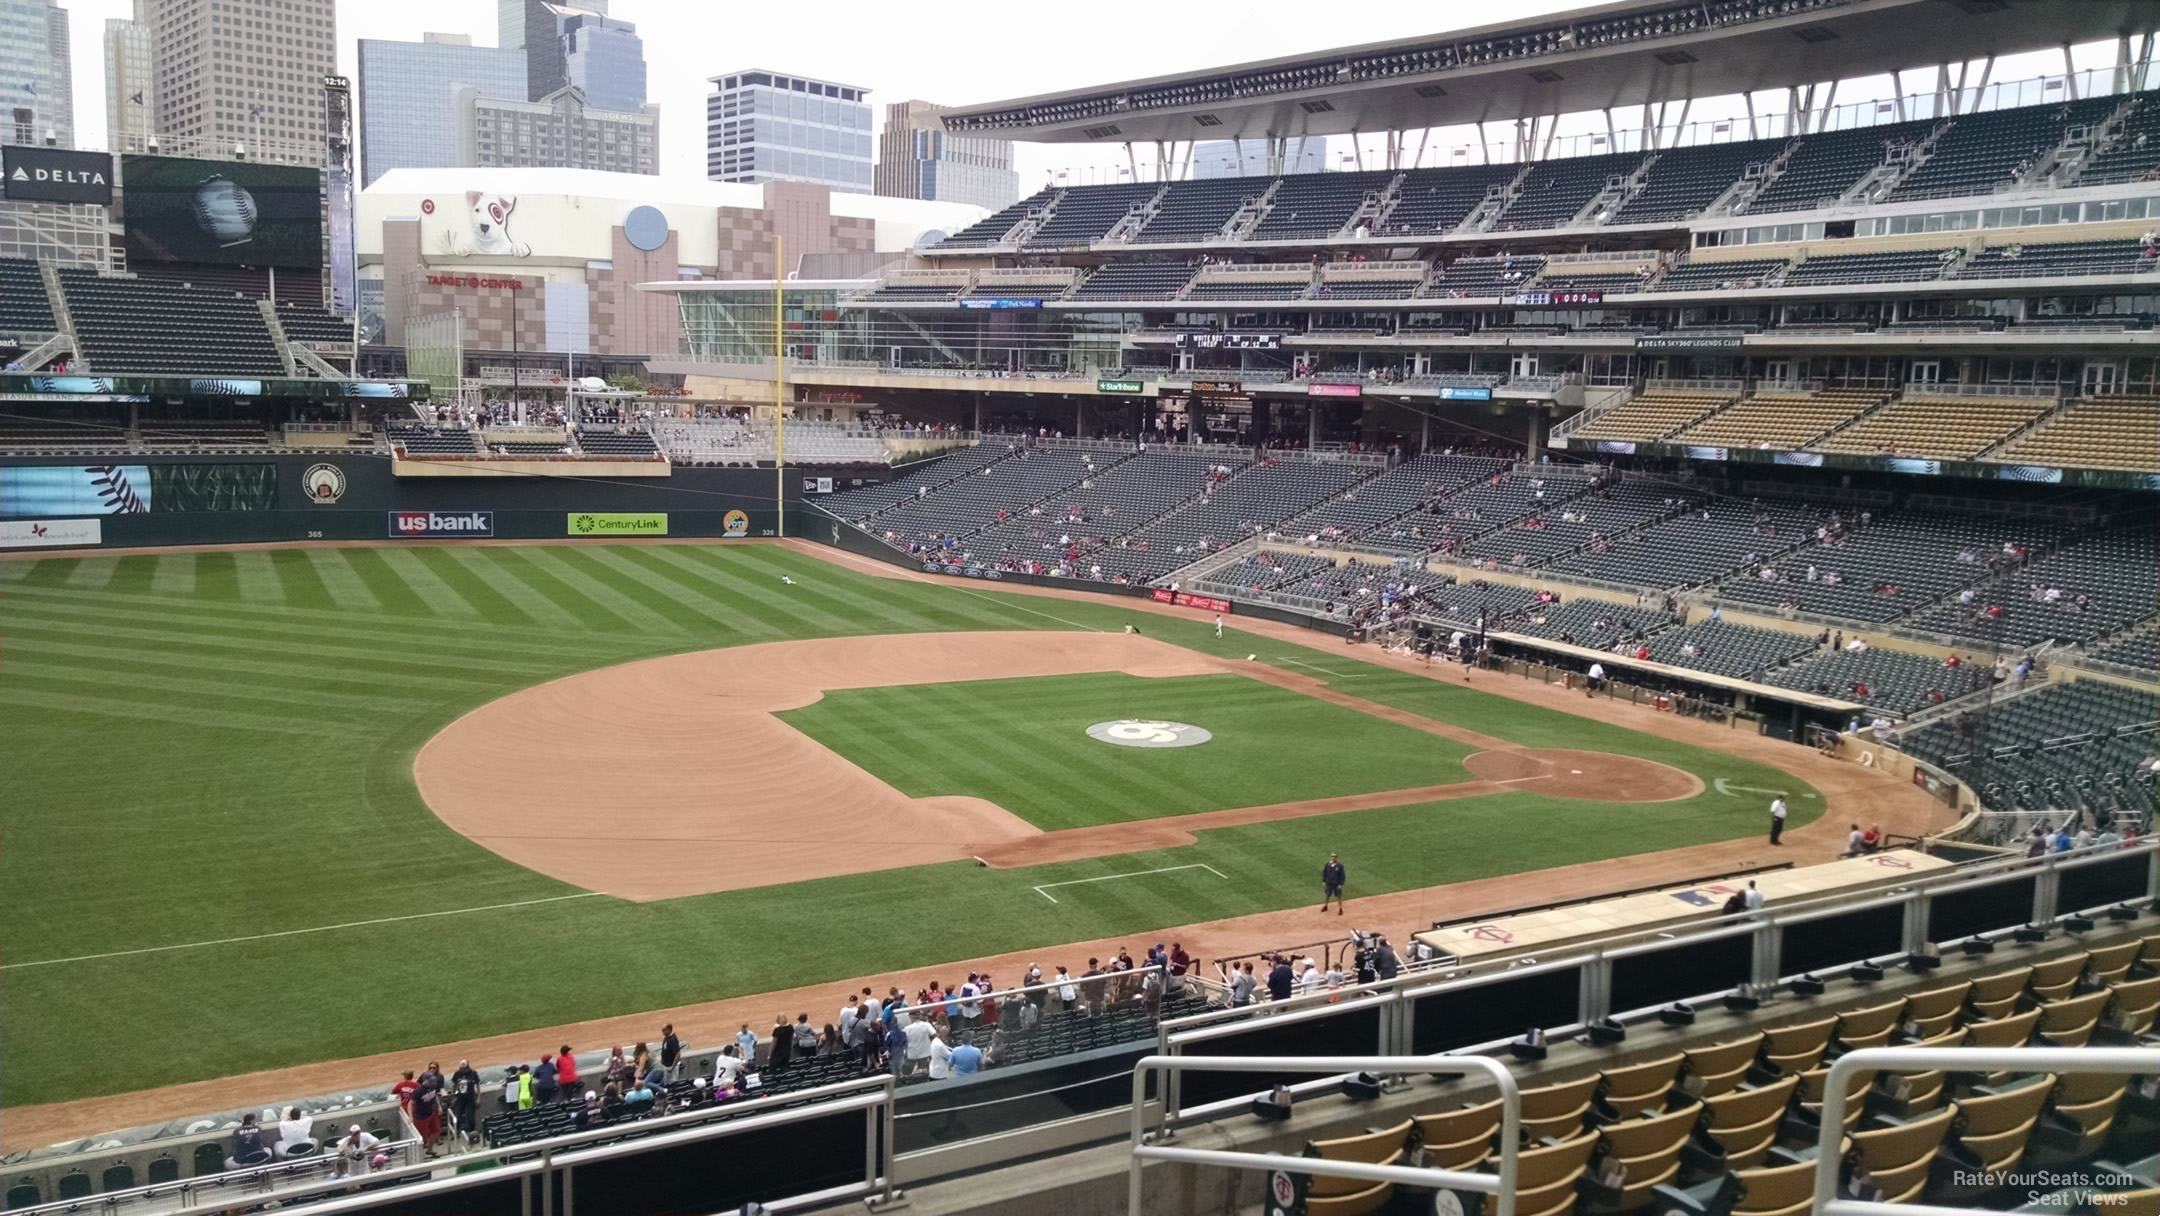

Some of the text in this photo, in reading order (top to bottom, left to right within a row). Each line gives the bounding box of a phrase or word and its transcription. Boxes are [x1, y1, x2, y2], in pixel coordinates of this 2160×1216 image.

[325, 77, 347, 86] 12:14
[604, 112, 633, 121] LOEWS
[35, 168, 105, 185] DELTA
[426, 275, 522, 290] TARGET CENTER
[1564, 294, 1570, 302] 0
[1573, 294, 1579, 302] 0
[1581, 293, 1587, 302] 0
[1723, 339, 1741, 347] CLUB
[598, 519, 660, 530] CenturyLink
